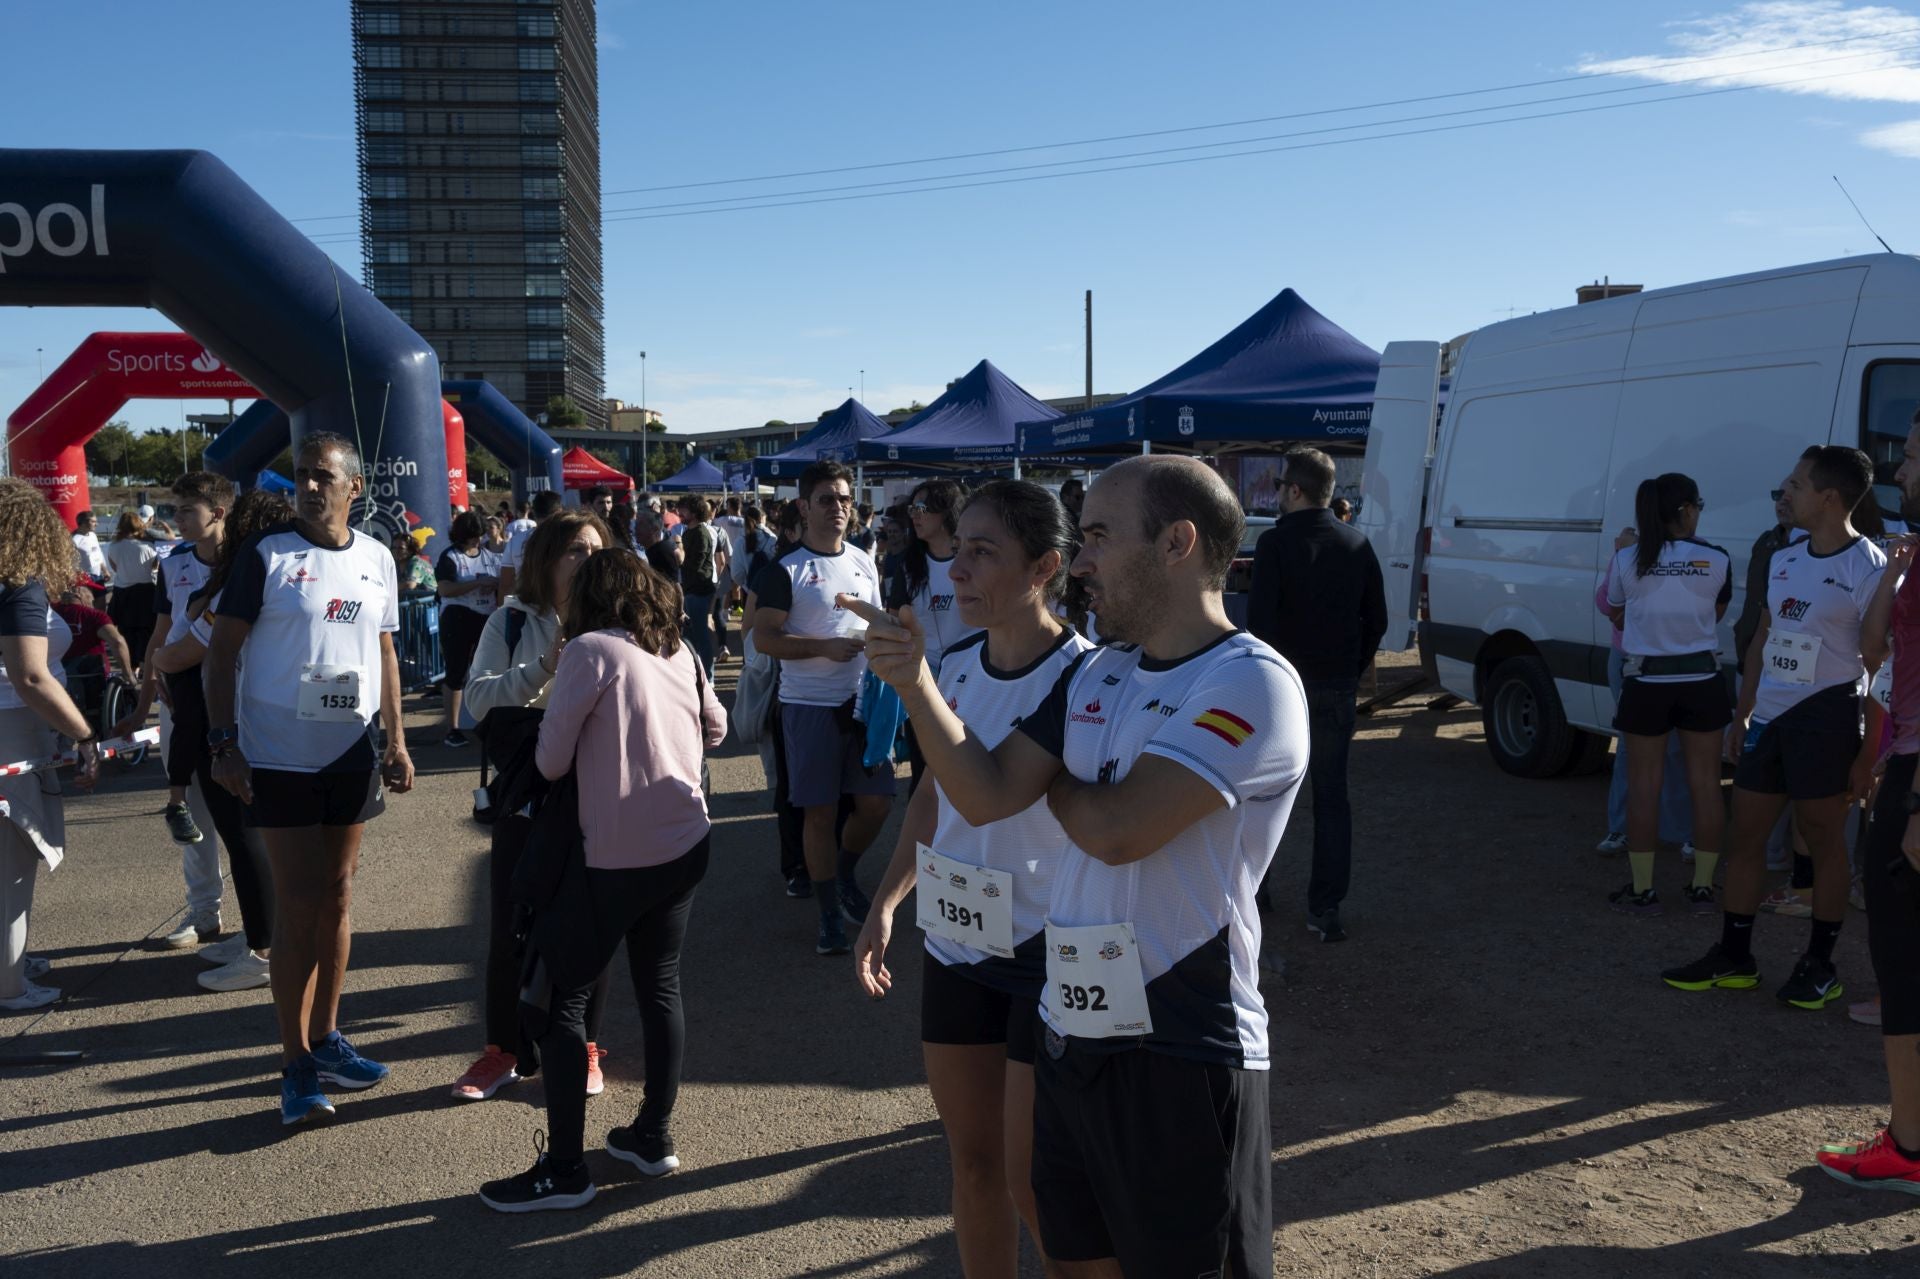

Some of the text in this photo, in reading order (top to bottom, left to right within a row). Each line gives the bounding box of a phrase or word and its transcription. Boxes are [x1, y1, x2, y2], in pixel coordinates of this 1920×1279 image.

[107, 349, 186, 376] Sports
[20, 459, 58, 472] Sports
[1772, 655, 1798, 671] 1439
[320, 694, 356, 709] 1532
[938, 898, 983, 931] 1391
